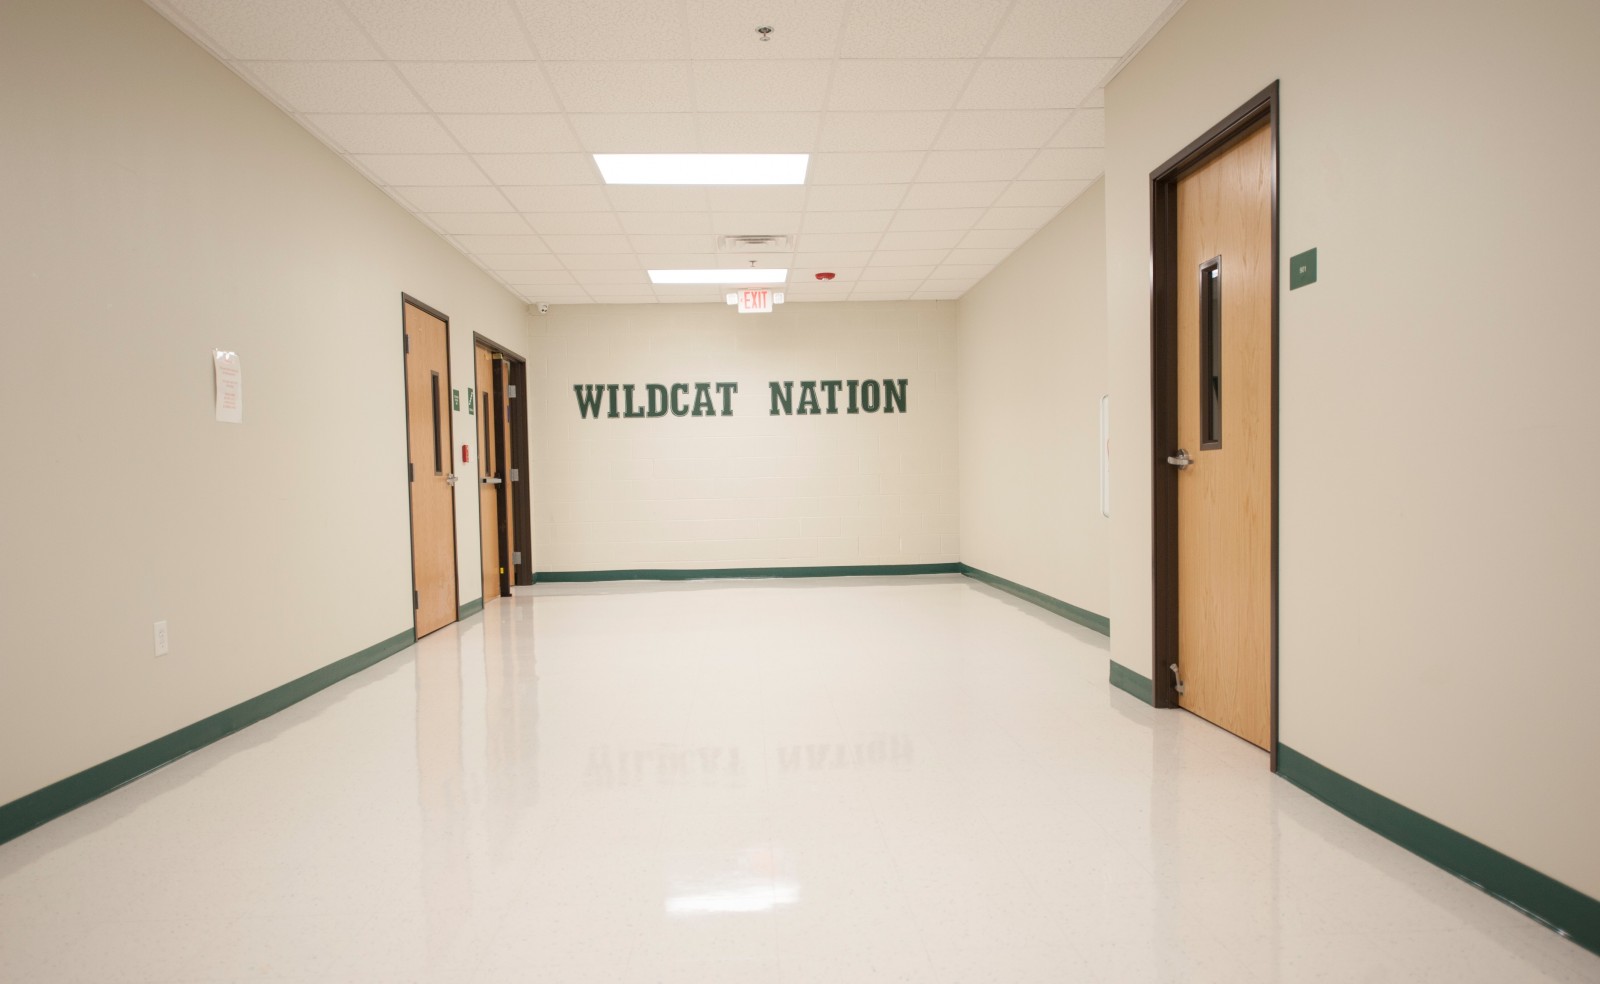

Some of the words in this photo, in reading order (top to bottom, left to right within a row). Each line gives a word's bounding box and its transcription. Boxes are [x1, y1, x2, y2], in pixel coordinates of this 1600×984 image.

[744, 291, 767, 309] EXIT
[573, 382, 738, 419] WILDCAT
[769, 379, 908, 415] NATION
